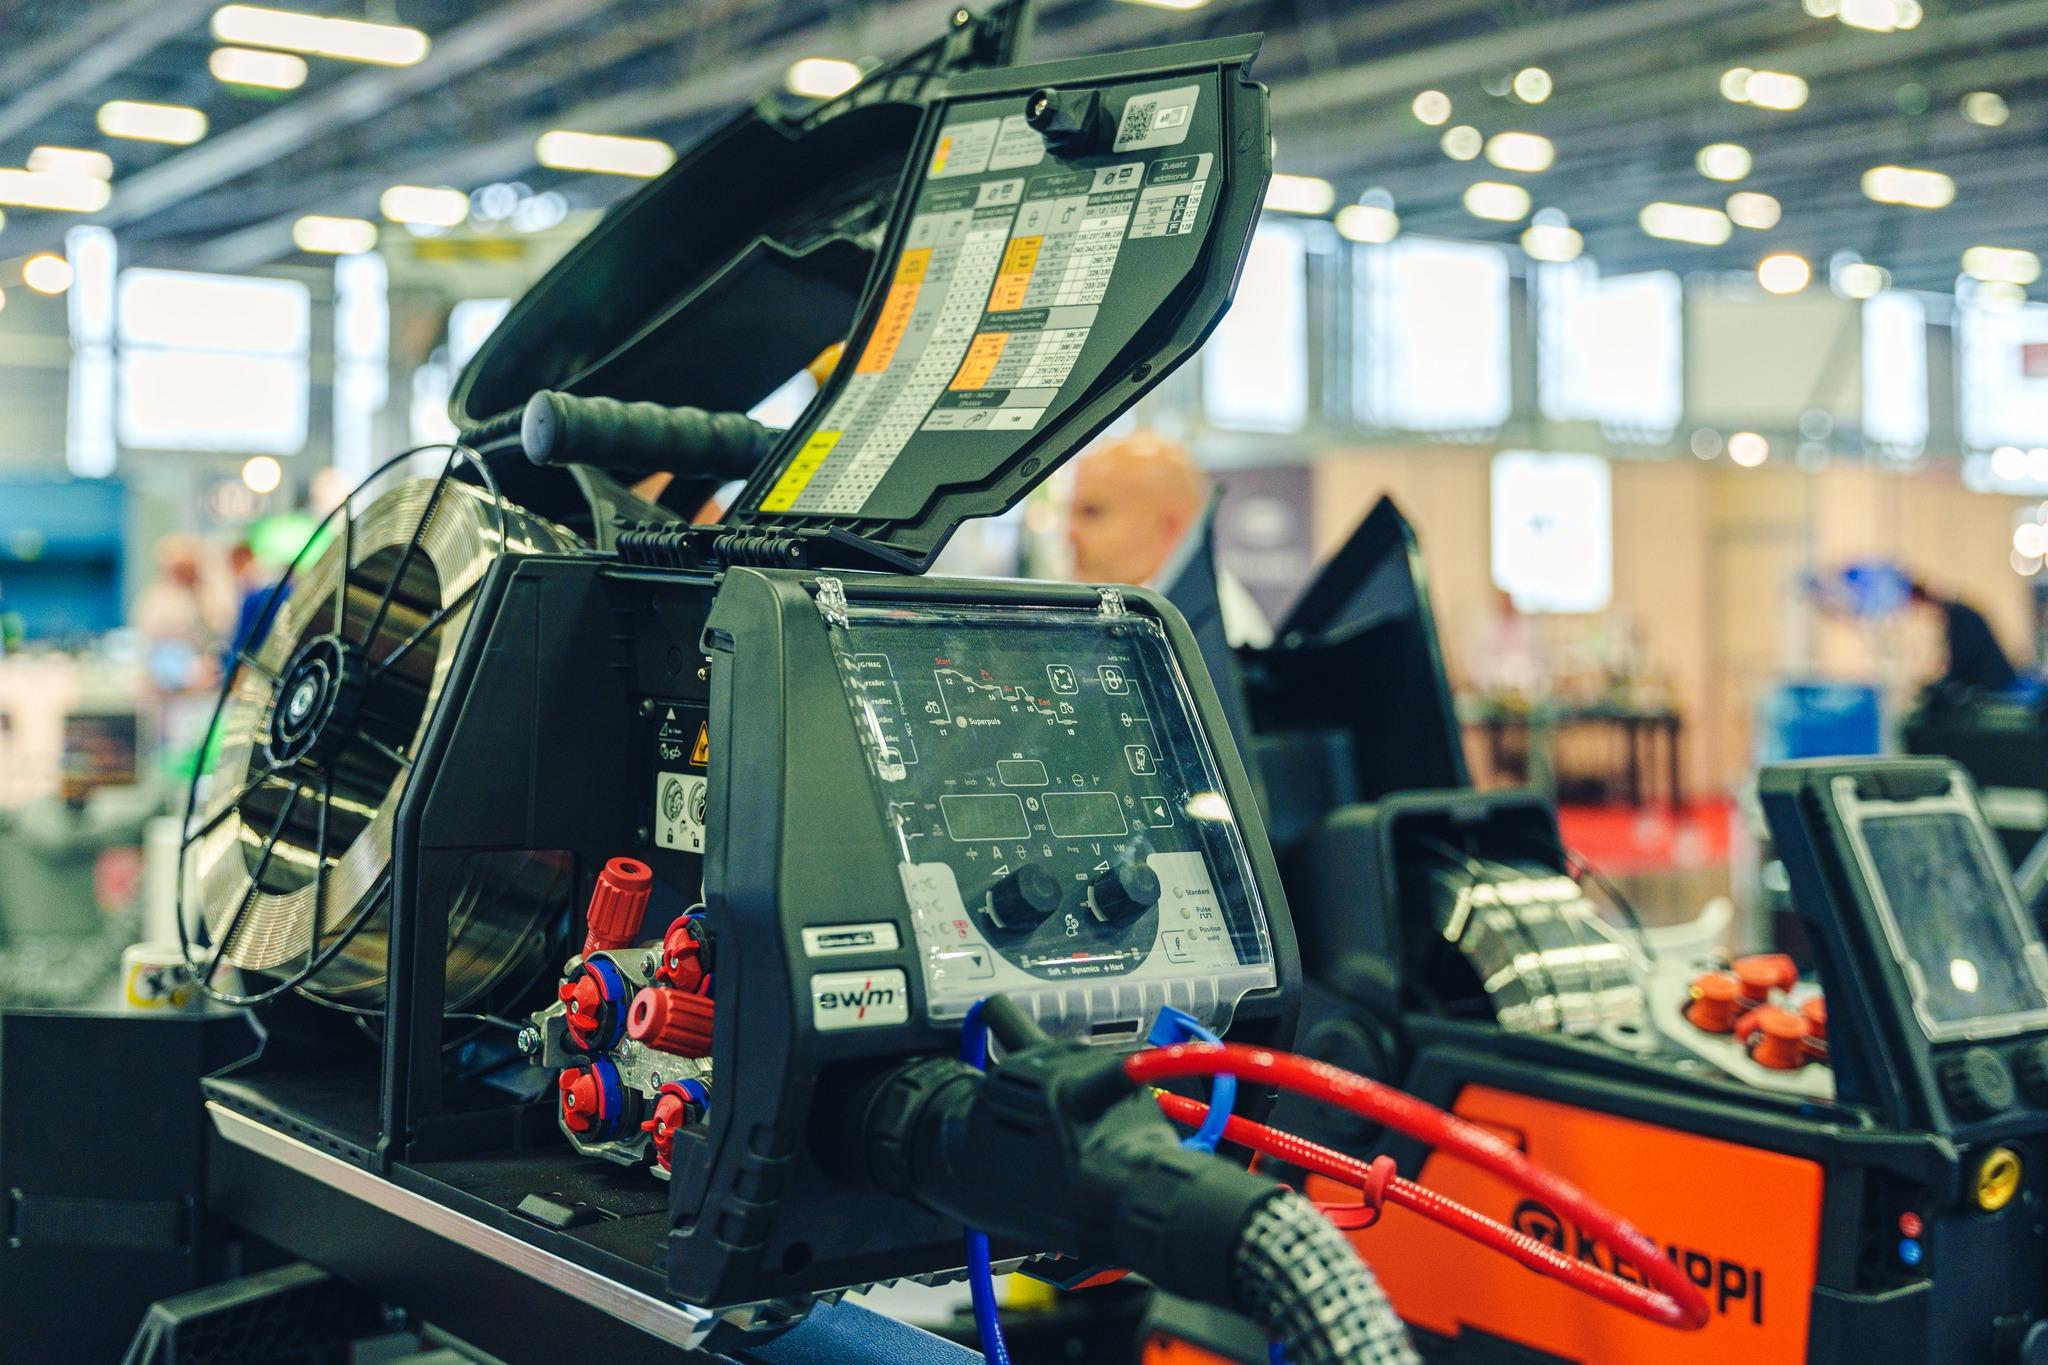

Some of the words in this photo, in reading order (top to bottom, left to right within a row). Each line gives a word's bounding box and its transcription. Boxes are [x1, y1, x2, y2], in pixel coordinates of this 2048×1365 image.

[1161, 161, 1188, 171] Zusatz
[1153, 171, 1189, 183] additional
[935, 657, 951, 665] Start
[1038, 698, 1051, 706] End
[1010, 705, 1019, 713] t5
[968, 717, 1001, 726] Superpuls
[940, 729, 948, 737] t1
[1012, 752, 1023, 760] JOB
[964, 778, 978, 786] Inch
[1033, 823, 1047, 832] VRD
[1091, 843, 1101, 856] V
[1113, 844, 1125, 852] kW
[992, 846, 1003, 859] A
[1185, 888, 1210, 897] Standard
[1196, 906, 1211, 914] Pulse
[1199, 925, 1222, 933] Position
[1207, 934, 1221, 942] weld
[1048, 967, 1062, 976] Soft
[1071, 966, 1100, 976] Dynamics
[1109, 963, 1124, 972] Hard
[820, 985, 893, 1012] ewm
